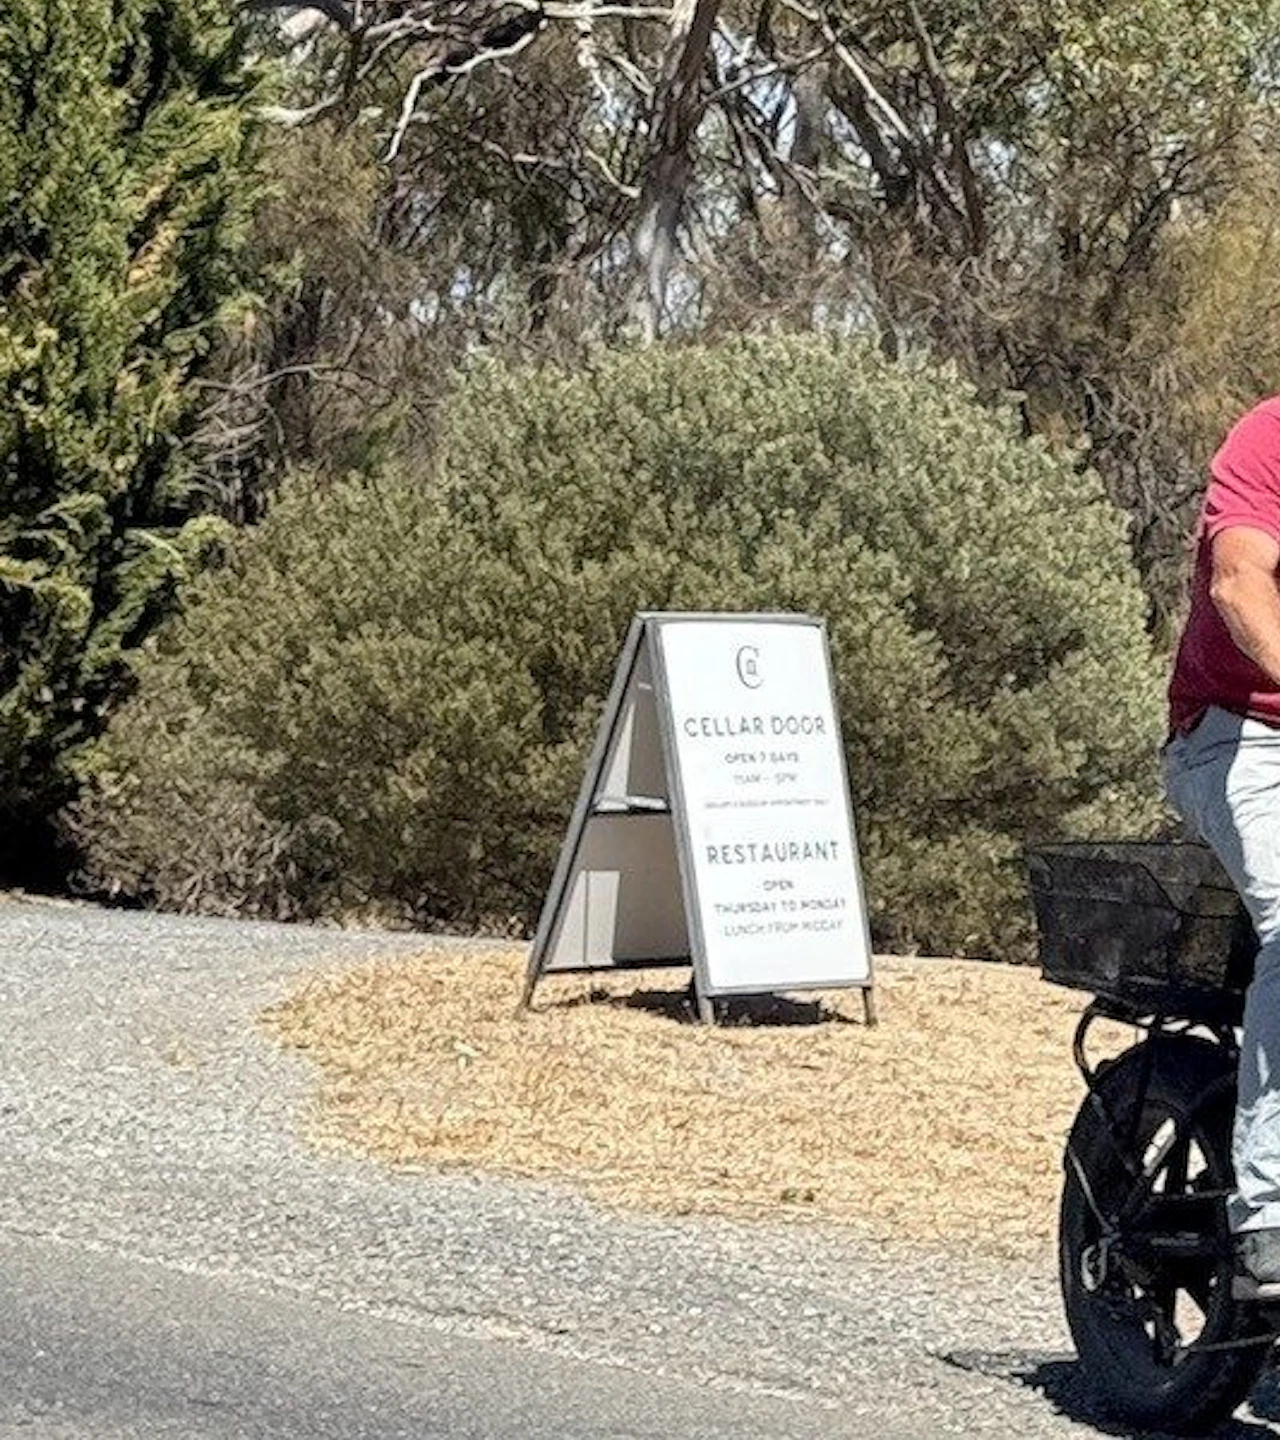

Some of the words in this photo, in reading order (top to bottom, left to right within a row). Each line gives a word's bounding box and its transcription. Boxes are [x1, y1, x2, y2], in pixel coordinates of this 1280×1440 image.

[683, 716, 764, 737] CELLAR
[771, 715, 827, 735] DOOR
[724, 752, 757, 764] OPEN
[770, 750, 799, 764] DAYS
[706, 841, 838, 865] RESTAURANT
[763, 879, 794, 891] OPEN
[714, 900, 777, 914] THURSDAY
[780, 899, 797, 911] TO
[801, 897, 846, 911] MONDAY
[723, 924, 765, 937] LUNCH
[768, 921, 799, 935] FROM
[801, 919, 843, 932] MIDDAY
